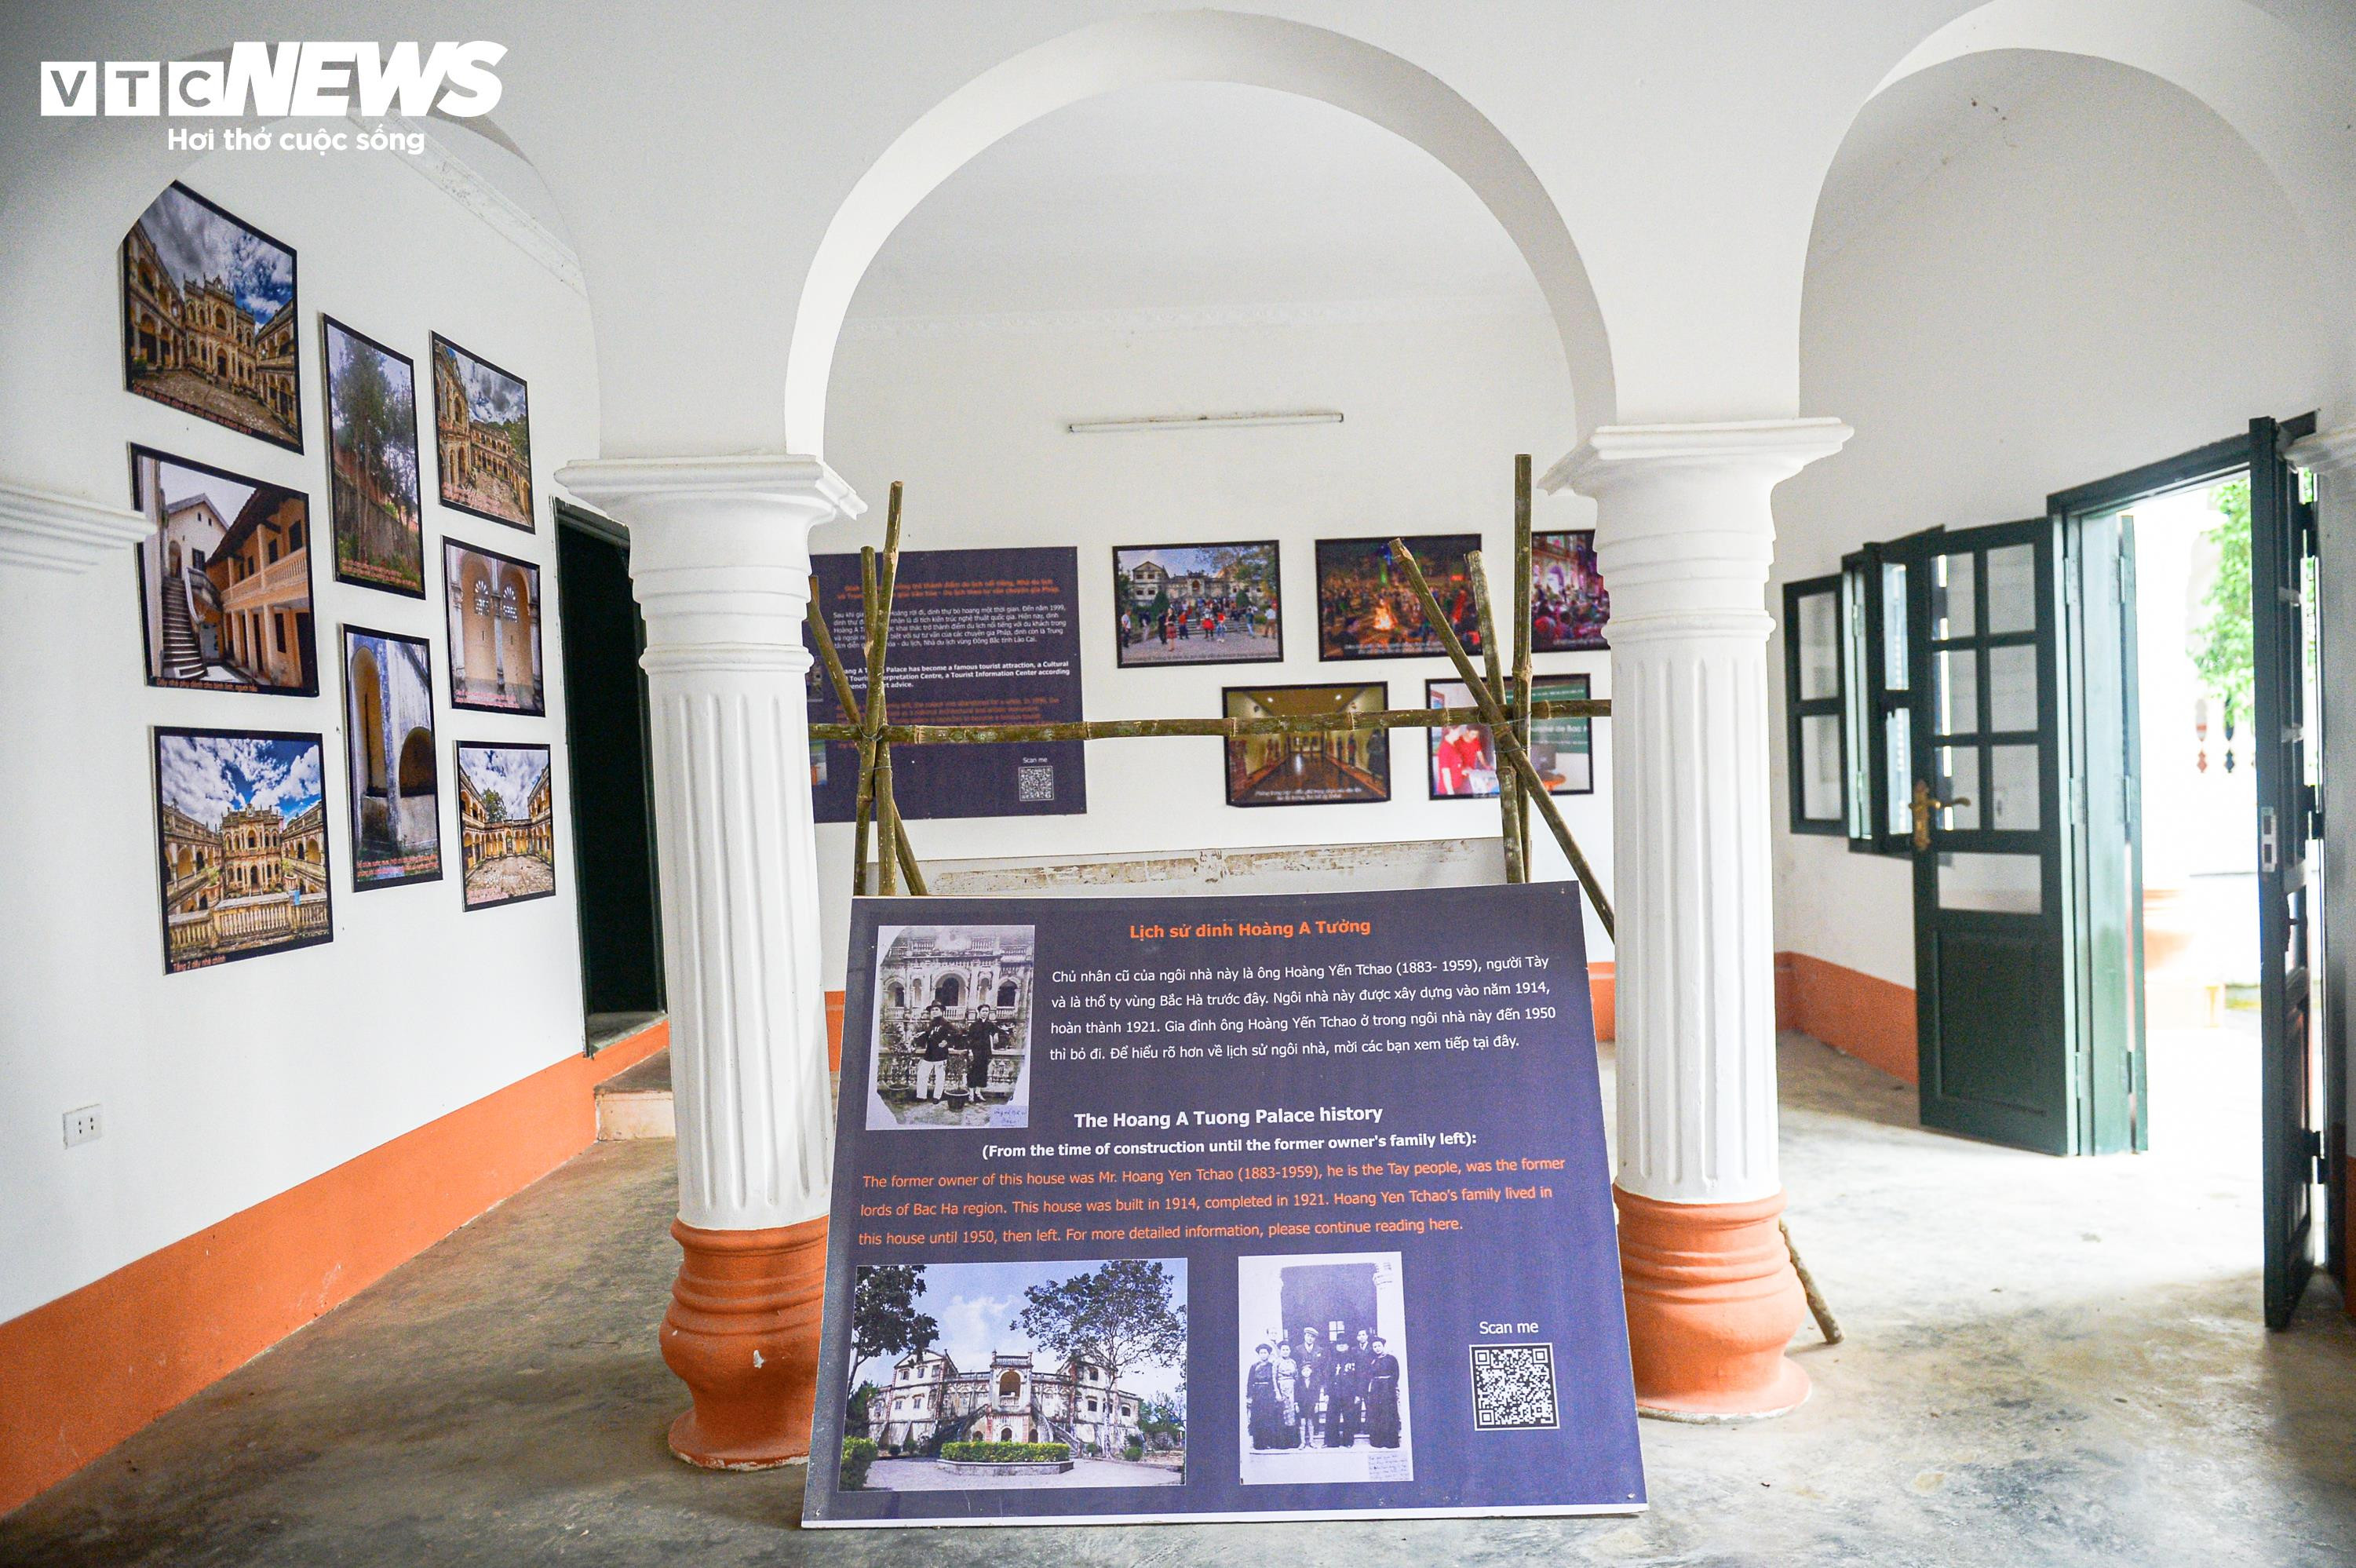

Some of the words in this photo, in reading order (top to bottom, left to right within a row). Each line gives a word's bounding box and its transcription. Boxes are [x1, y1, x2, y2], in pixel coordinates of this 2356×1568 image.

[1129, 924, 1165, 942] Lịch
[1169, 924, 1192, 938] sử
[1195, 923, 1233, 938] dinh
[1238, 921, 1294, 939] Hoàng
[1299, 921, 1311, 935] A
[1315, 919, 1371, 935] Tưởng
[1052, 970, 1076, 983] Chủ
[1081, 969, 1111, 983] nhân
[1114, 969, 1129, 982] cũ
[1133, 968, 1155, 982] của
[1159, 968, 1186, 983] ngôi
[1190, 968, 1213, 980] nhà
[1216, 967, 1239, 982] này
[1242, 966, 1253, 979] là
[1257, 966, 1281, 981] ông
[1285, 965, 1325, 979] Hoàng
[1328, 963, 1352, 976] Yến
[1355, 963, 1392, 975] Tchao
[1396, 961, 1438, 976] (1883-
[1442, 958, 1483, 973] 1959),
[1486, 956, 1522, 972] người
[1524, 954, 1549, 970] Tày
[1051, 995, 1066, 1008] và
[1070, 995, 1081, 1008] là
[1085, 994, 1106, 1008] thổ
[1109, 996, 1121, 1010] ty
[1125, 994, 1155, 1009] vùng
[1160, 993, 1183, 1006] Bắc
[1186, 993, 1203, 1006] Hà
[1206, 992, 1240, 1005] trước
[1243, 991, 1269, 1007] đây.
[1273, 990, 1301, 1006] Ngôi
[1305, 990, 1329, 1003] nhà
[1333, 989, 1355, 1004] này
[1359, 989, 1391, 1003] được
[1394, 986, 1417, 1001] xây
[1420, 986, 1453, 1001] dựng
[1456, 983, 1479, 997] vào
[1483, 983, 1511, 996] năm
[1515, 981, 1550, 995] 1914,
[1049, 1047, 1067, 1060] thì
[1070, 1047, 1086, 1060] bỏ
[1089, 1048, 1105, 1059] đi.
[1110, 1045, 1129, 1059] Để
[1132, 1045, 1158, 1059] hiểu
[1162, 1045, 1176, 1059] rõ
[1180, 1045, 1204, 1058] hơn
[1207, 1044, 1223, 1057] về
[1227, 1044, 1248, 1059] lịch
[1251, 1043, 1268, 1056] sử
[1271, 1041, 1298, 1058] ngôi
[1302, 1041, 1329, 1056] nhà,
[1334, 1040, 1358, 1054] mời
[1361, 1039, 1384, 1052] các
[1386, 1039, 1410, 1054] bạn
[1413, 1040, 1442, 1051] xem
[1444, 1035, 1469, 1052] tiếp
[1472, 1036, 1490, 1051] tại
[1493, 1034, 1519, 1049] đây.
[1074, 1113, 1108, 1128] The
[1113, 1112, 1171, 1130] Hoang
[1176, 1111, 1189, 1126] A
[1193, 1110, 1250, 1128] Tuong
[1256, 1107, 1315, 1124] Palace
[1319, 1106, 1384, 1124] history
[982, 1144, 1026, 1161] (From
[1030, 1143, 1055, 1157] the
[1058, 1143, 1092, 1156] time
[1095, 1142, 1111, 1155] of
[1113, 1140, 1205, 1154] construction
[1209, 1139, 1242, 1153] until
[1245, 1138, 1271, 1151] the
[1274, 1137, 1325, 1150] former
[1328, 1135, 1387, 1149] owner's
[1389, 1132, 1436, 1148] family
[1439, 1131, 1477, 1147] left):
[863, 1176, 887, 1187] The
[891, 1175, 934, 1187] former
[938, 1176, 979, 1187] owner
[983, 1172, 996, 1186] of
[999, 1173, 1023, 1185] this
[1027, 1172, 1065, 1185] house
[1070, 1174, 1095, 1184] was
[1099, 1171, 1117, 1183] Mr.
[1122, 1171, 1164, 1185] Hoang
[1168, 1169, 1191, 1181] Yen
[1195, 1168, 1234, 1181] Tchao
[1238, 1165, 1322, 1183] (1883-1959),
[1326, 1165, 1344, 1177] he
[1348, 1164, 1359, 1176] is
[1362, 1163, 1384, 1176] the
[1387, 1162, 1410, 1177] Tay
[1413, 1161, 1461, 1177] people,
[1465, 1161, 1493, 1172] was
[1495, 1158, 1518, 1172] the
[1520, 1158, 1566, 1171] former
[859, 1232, 882, 1245] this
[886, 1232, 925, 1245] house
[929, 1231, 957, 1244] until
[963, 1230, 997, 1244] 1950,
[1003, 1230, 1032, 1242] then
[1037, 1228, 1061, 1242] left.
[1066, 1228, 1087, 1241] For
[1091, 1230, 1125, 1240] more
[1129, 1226, 1180, 1240] detailed
[1185, 1223, 1264, 1238] information,
[1268, 1223, 1311, 1238] please
[1314, 1221, 1372, 1234] continue
[1375, 1219, 1425, 1234] reading
[1428, 1217, 1463, 1231] here.
[1479, 1321, 1513, 1335] Scan
[1516, 1322, 1539, 1333] me
